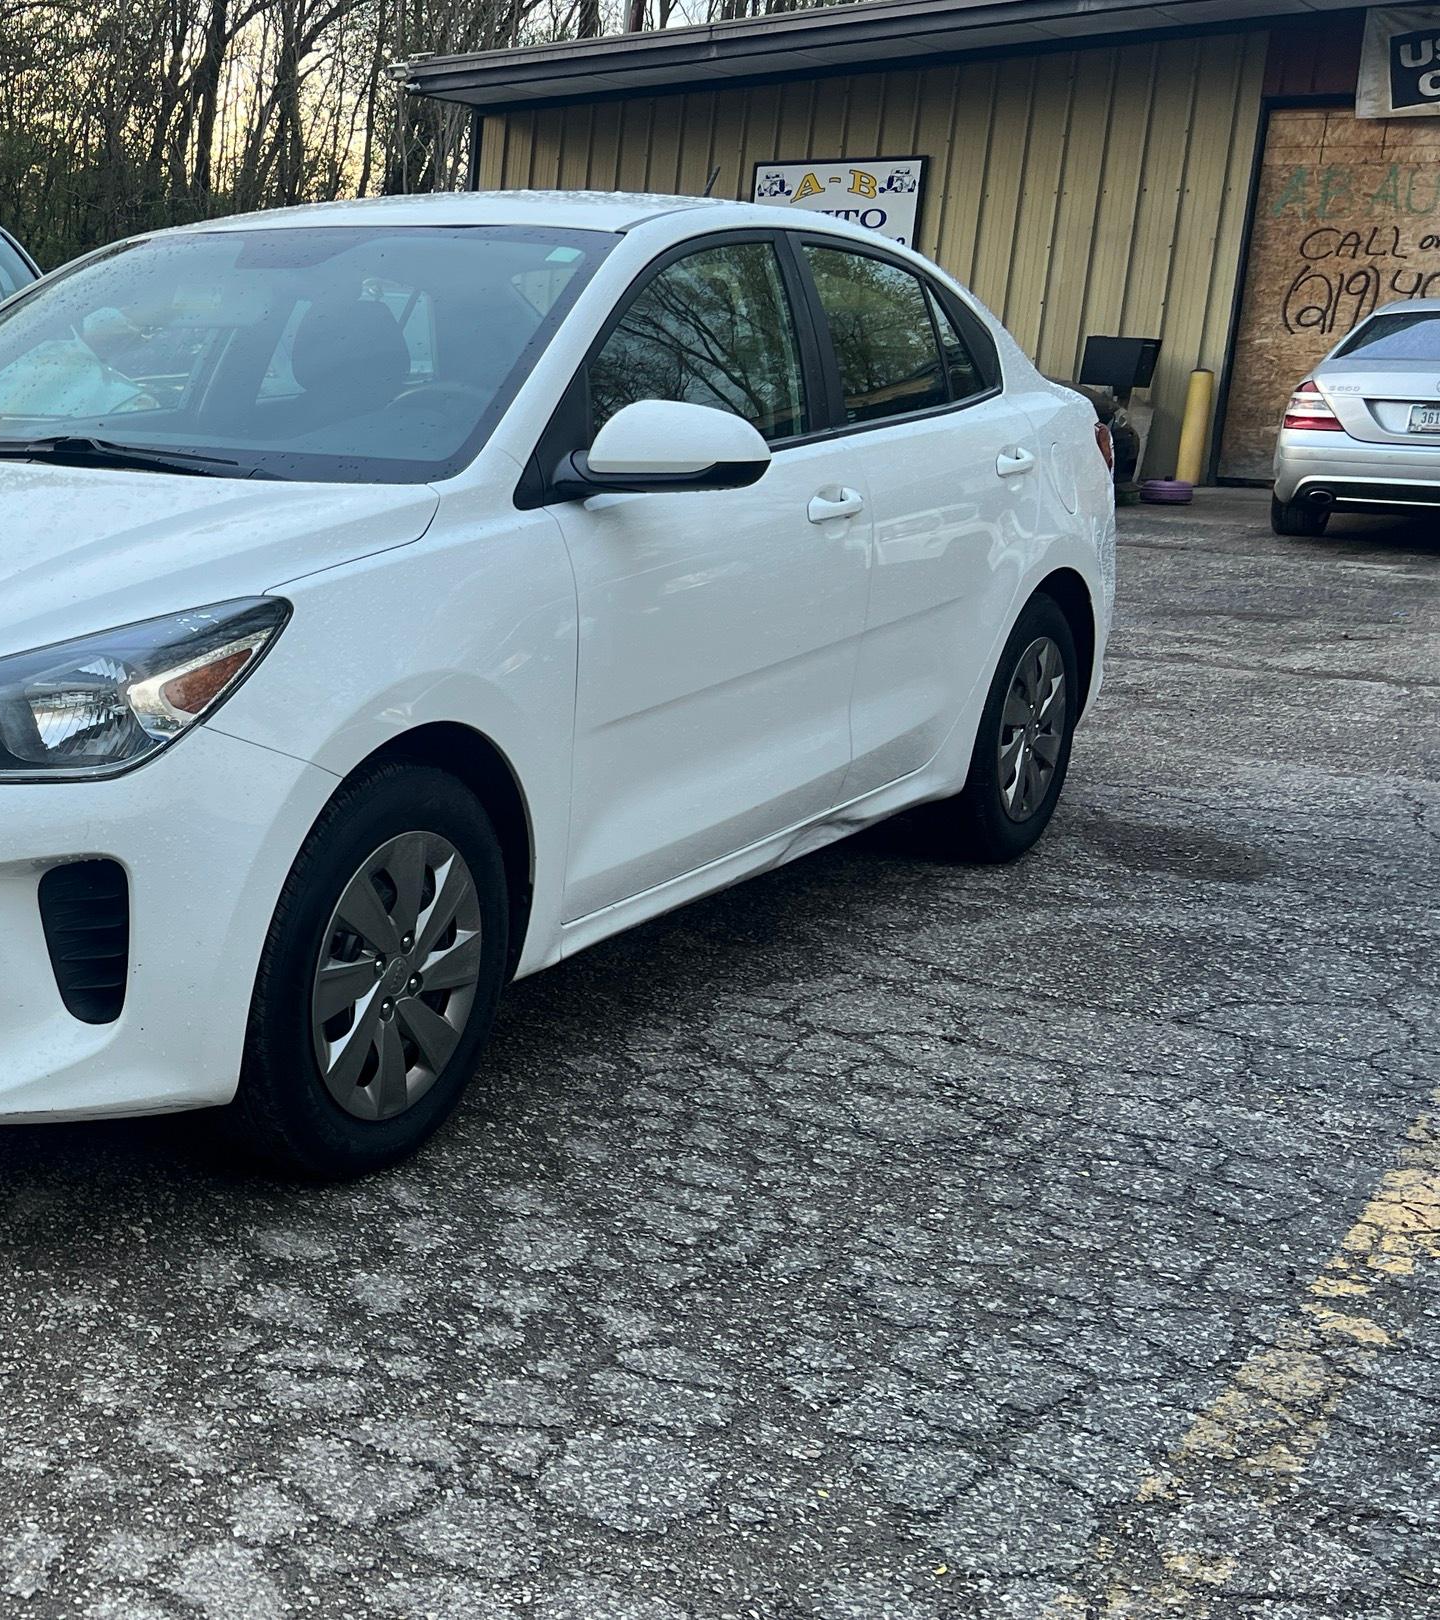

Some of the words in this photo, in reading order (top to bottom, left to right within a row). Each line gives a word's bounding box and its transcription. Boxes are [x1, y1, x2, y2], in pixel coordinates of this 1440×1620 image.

[1400, 38, 1440, 68] U
[1299, 226, 1408, 260] CALL
[1282, 265, 1380, 335] (219)
